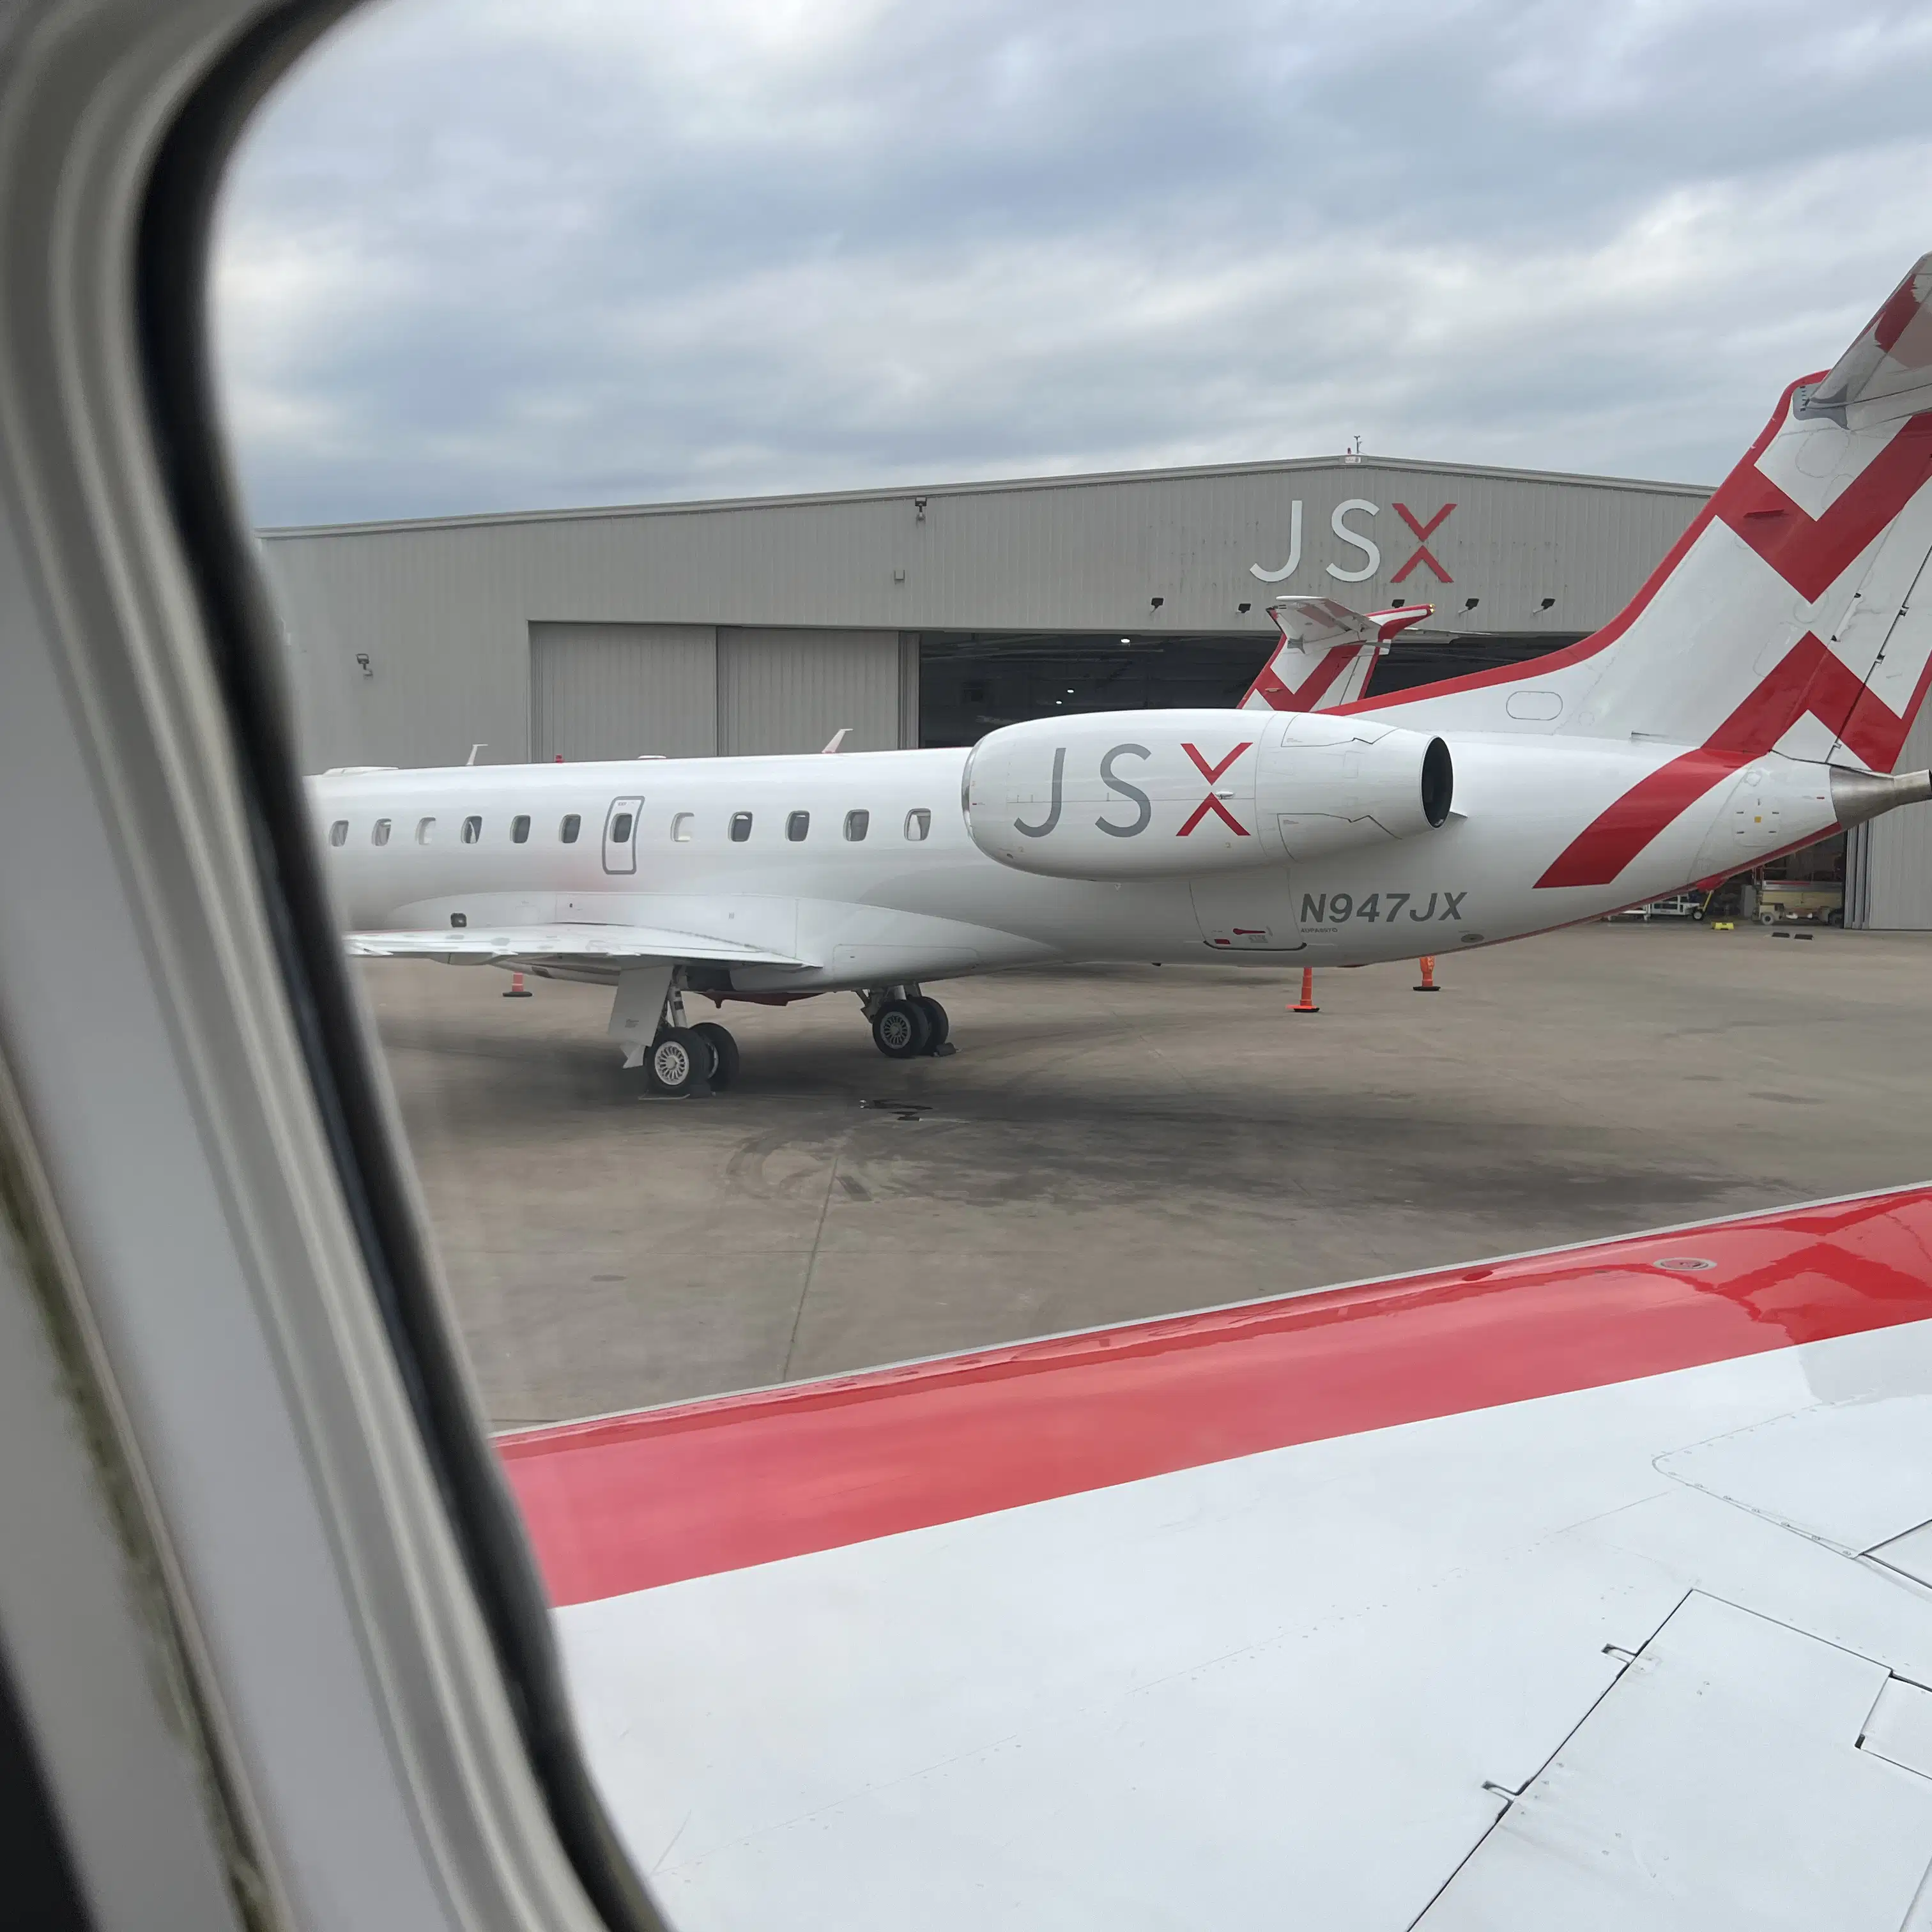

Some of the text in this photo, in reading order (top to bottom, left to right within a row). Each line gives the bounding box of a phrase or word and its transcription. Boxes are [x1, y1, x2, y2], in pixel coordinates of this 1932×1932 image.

[1250, 498, 1457, 583] JSX
[1013, 742, 1254, 838] JSX
[1300, 893, 1468, 923] N947JX
